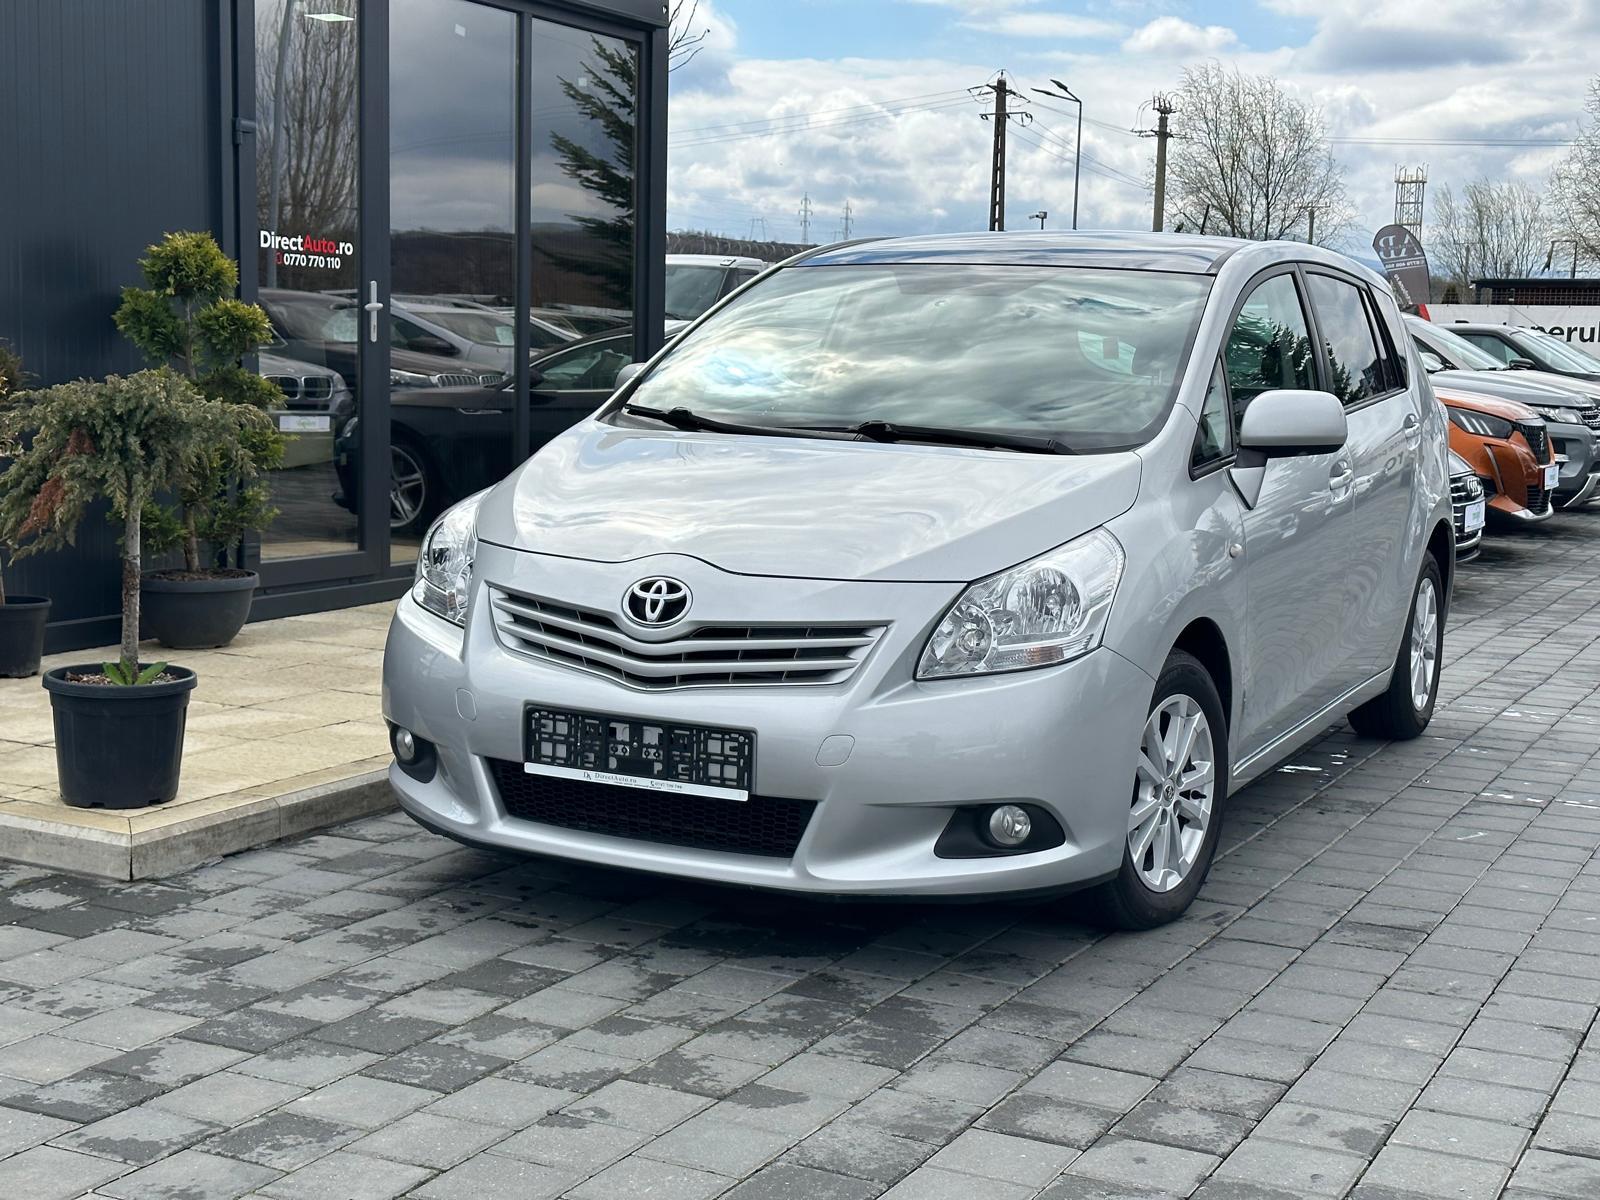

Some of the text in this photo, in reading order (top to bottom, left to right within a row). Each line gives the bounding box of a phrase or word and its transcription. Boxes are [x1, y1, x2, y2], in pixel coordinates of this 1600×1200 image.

[260, 230, 354, 255] DirectAuto.ro
[283, 253, 341, 269] 0770 770 110
